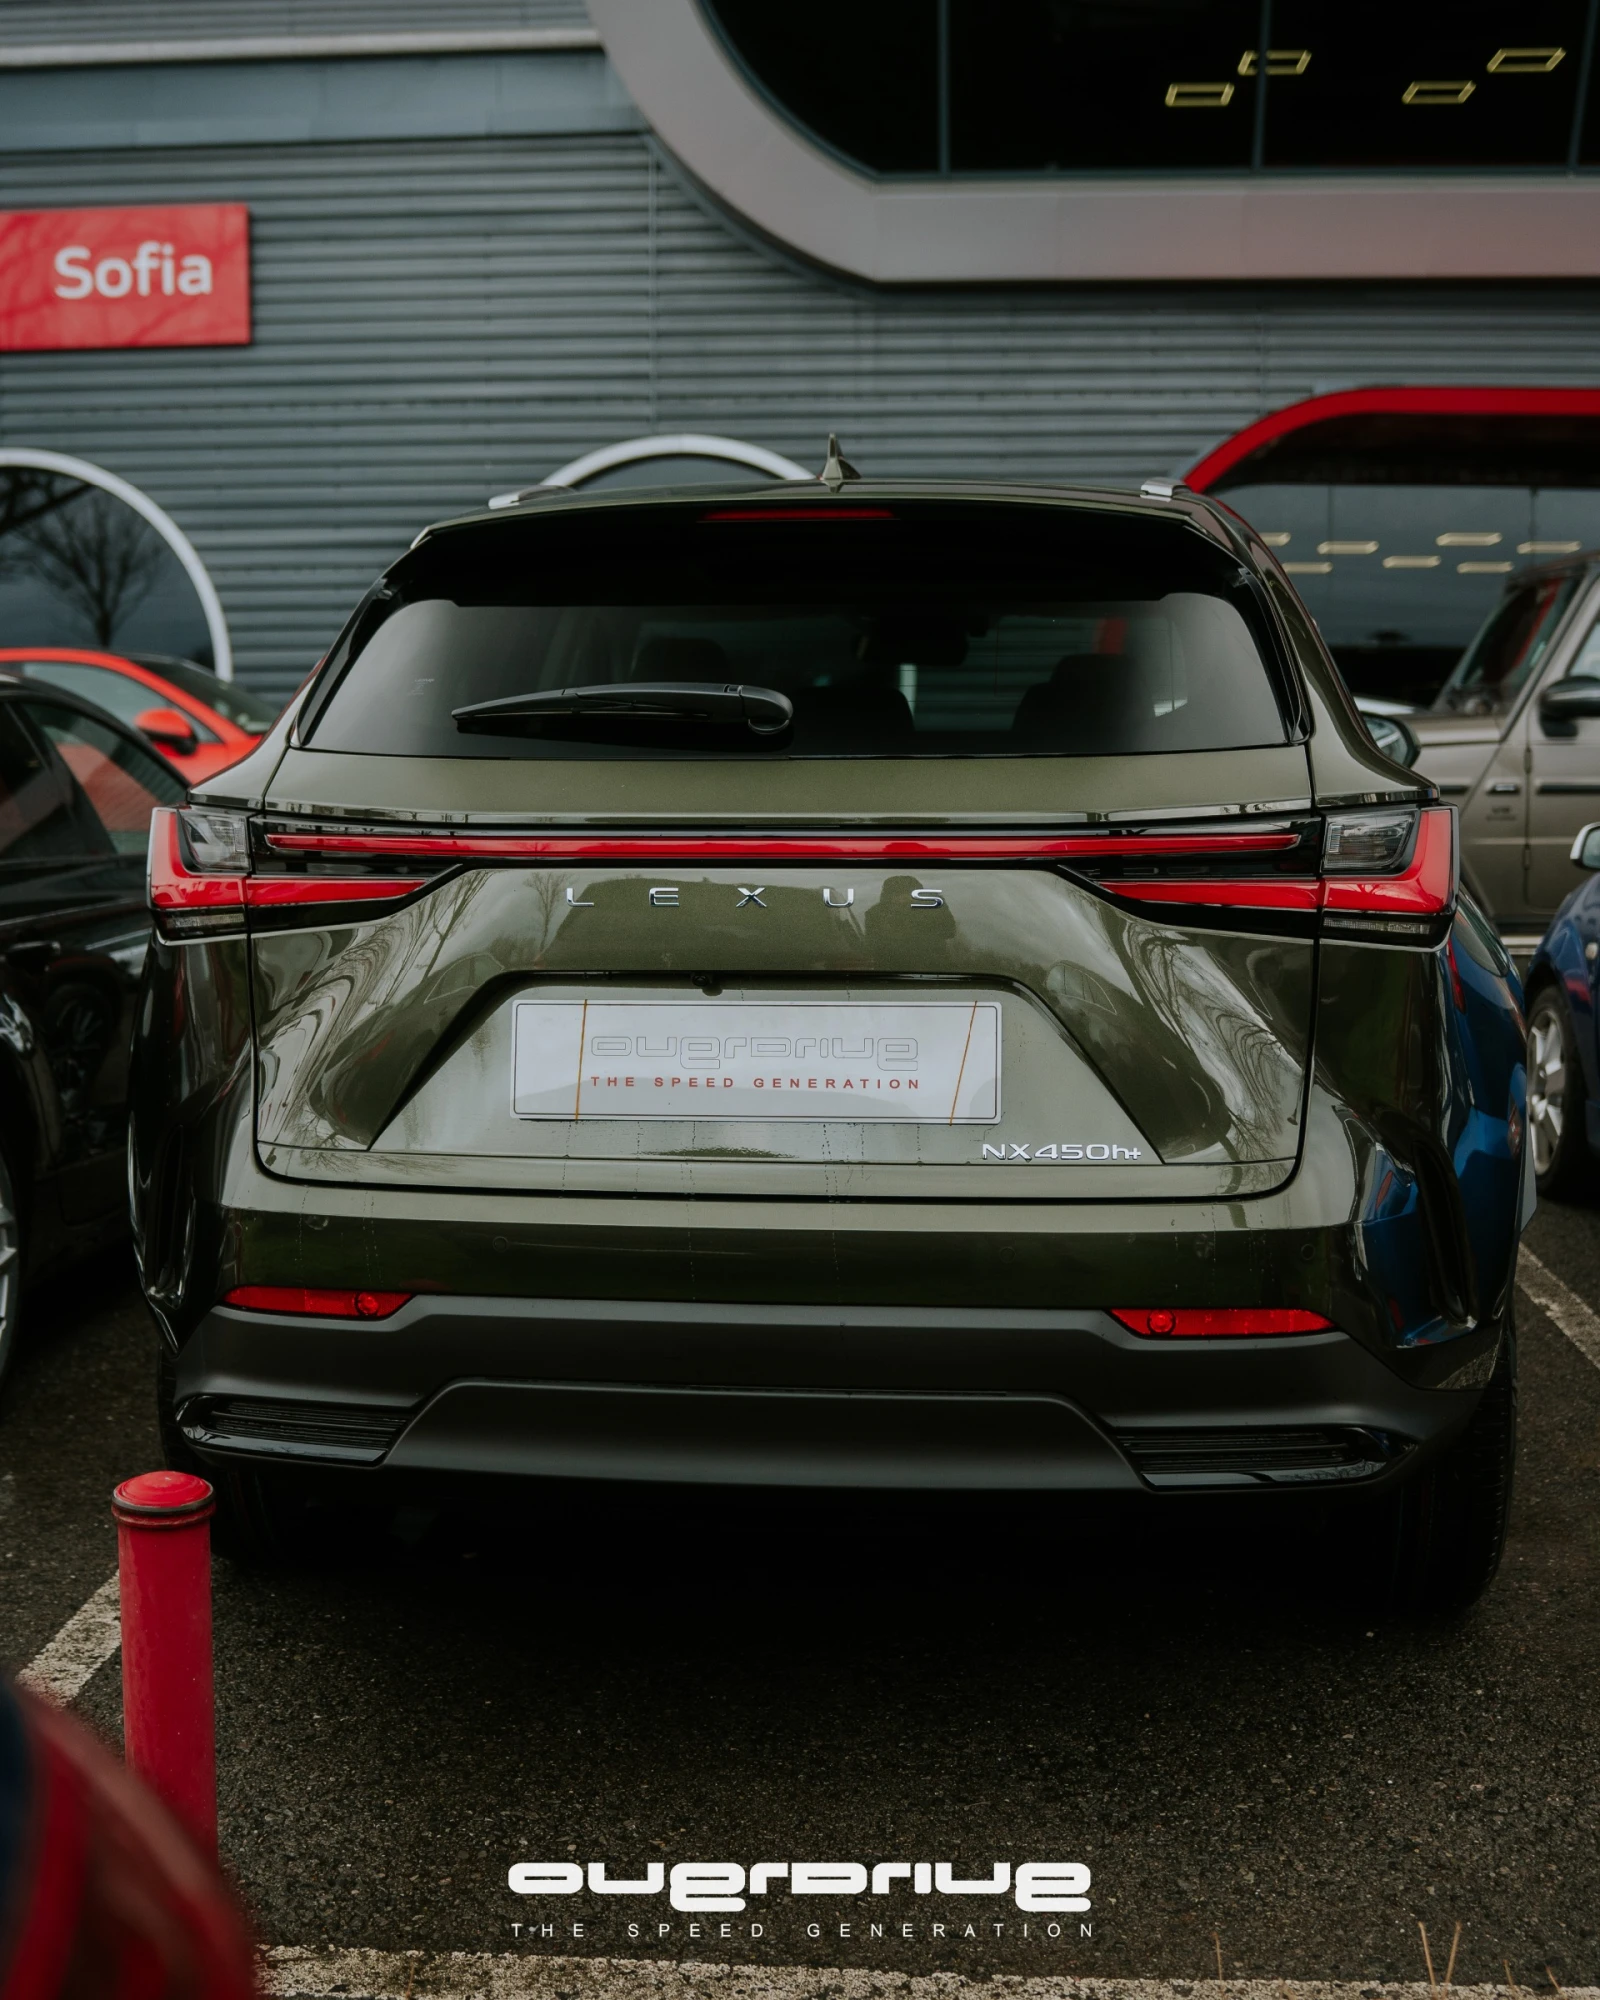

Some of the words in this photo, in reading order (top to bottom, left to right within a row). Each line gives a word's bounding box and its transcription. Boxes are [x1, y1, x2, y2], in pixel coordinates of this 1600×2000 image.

[54, 240, 213, 300] Sofia
[565, 887, 944, 909] LEXUS
[591, 1076, 635, 1087] THE
[654, 1077, 734, 1088] SPEED
[753, 1078, 919, 1090] GENERATION
